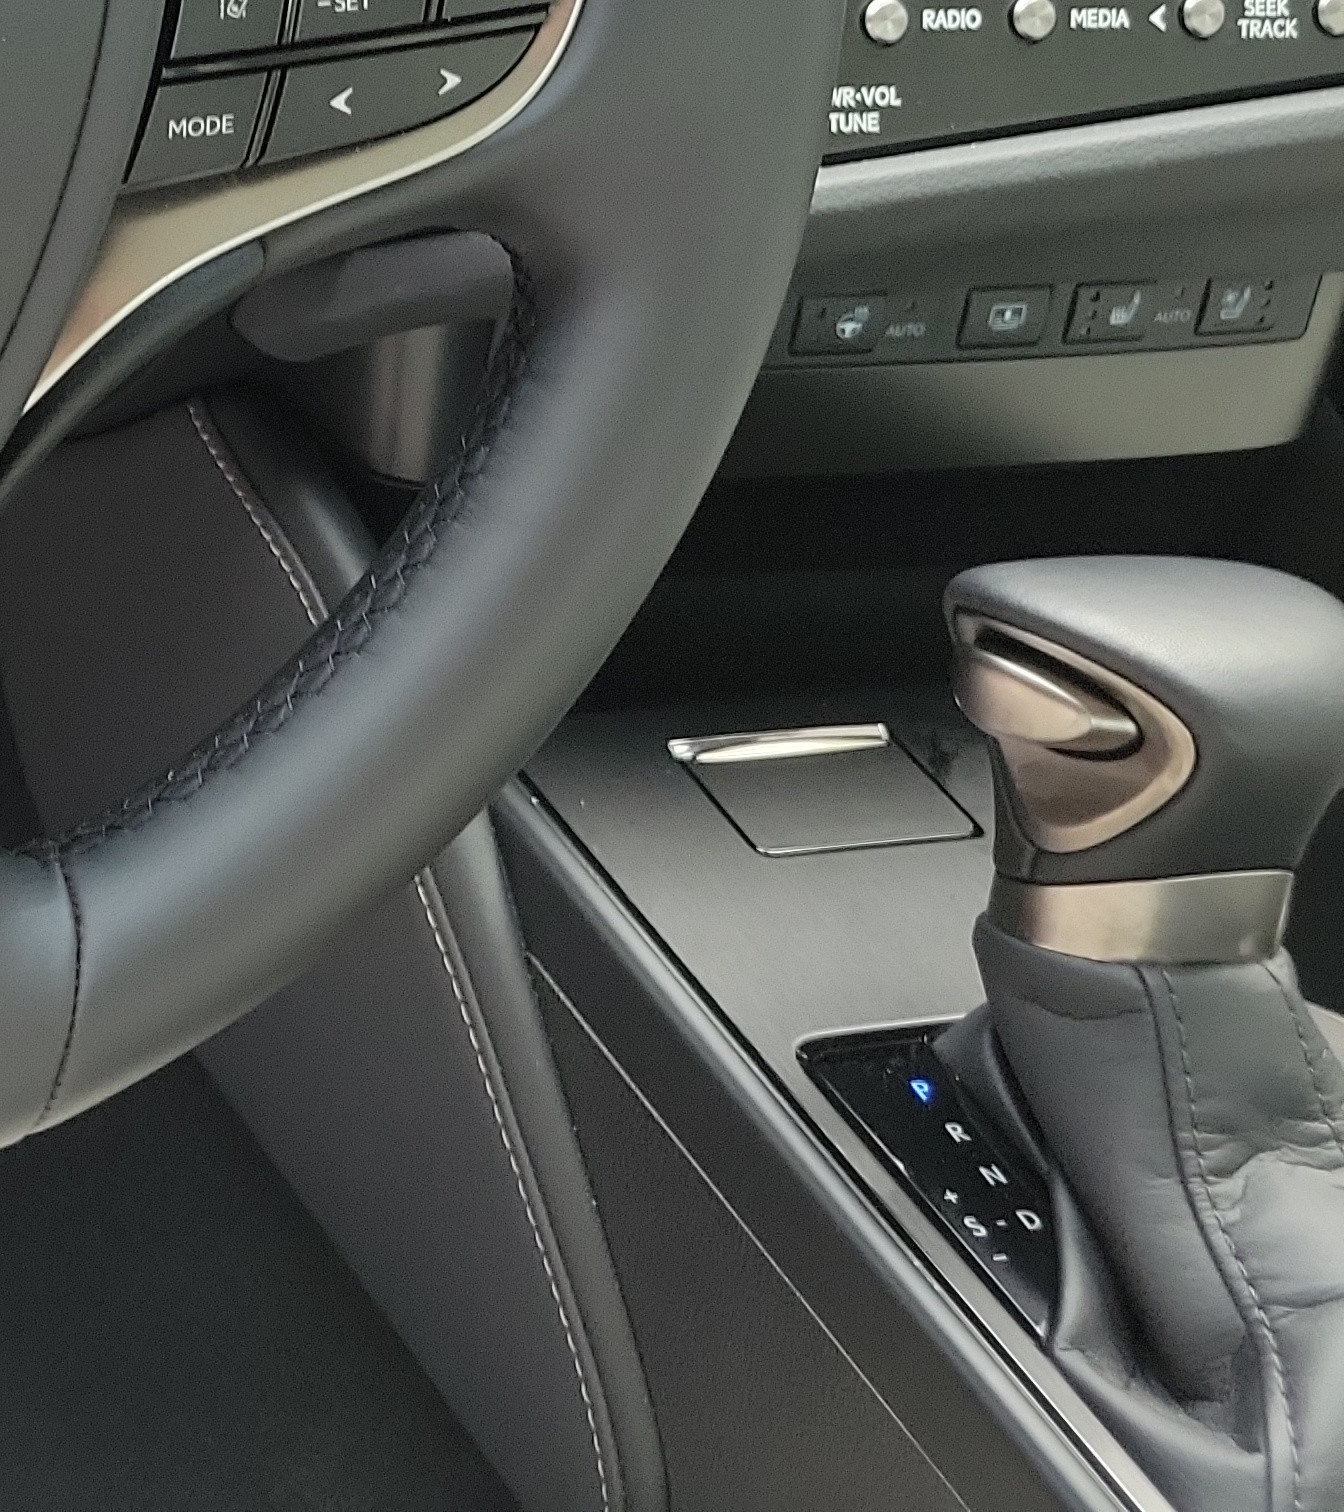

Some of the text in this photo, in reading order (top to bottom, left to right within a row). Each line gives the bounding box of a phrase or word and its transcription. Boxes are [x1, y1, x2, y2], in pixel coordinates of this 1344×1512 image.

[921, 7, 983, 33] RADIO
[1069, 7, 1130, 31] MEDIA
[1237, 16, 1298, 40] TRACK
[167, 114, 236, 140] MODE
[828, 110, 882, 135] TUNE
[910, 1078, 930, 1103] P
[944, 1121, 973, 1144] R
[978, 1162, 1009, 1187] N
[962, 1214, 989, 1238] S
[1015, 1208, 1044, 1232] D
